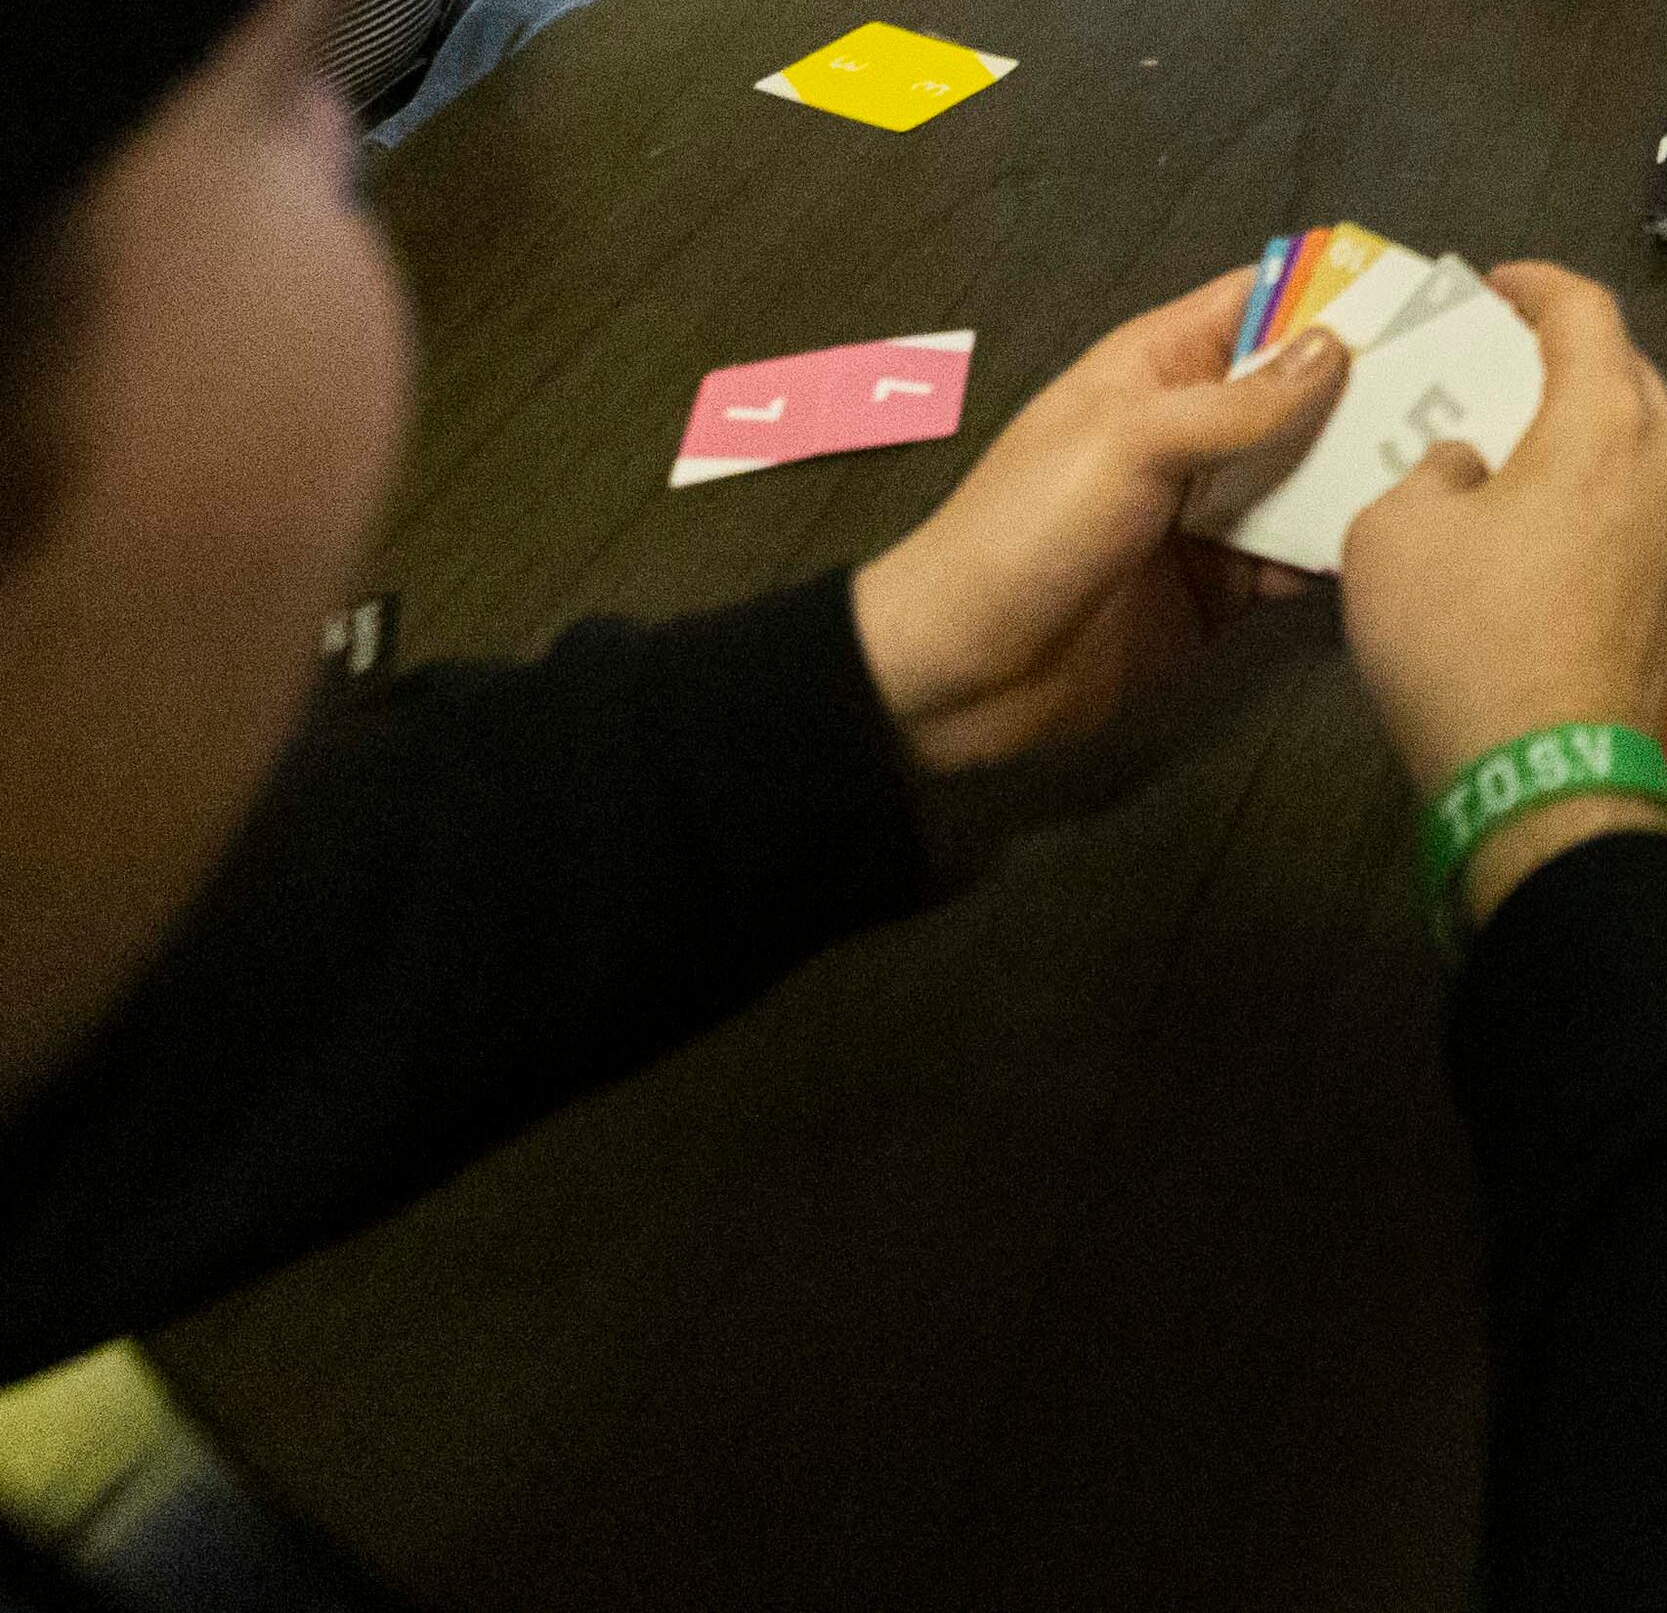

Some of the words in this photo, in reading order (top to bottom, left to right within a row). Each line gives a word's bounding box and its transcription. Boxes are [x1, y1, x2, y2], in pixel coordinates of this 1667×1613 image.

[828, 53, 869, 74] 3
[910, 79, 951, 99] 3
[873, 377, 935, 405] 7
[724, 396, 785, 424] 7
